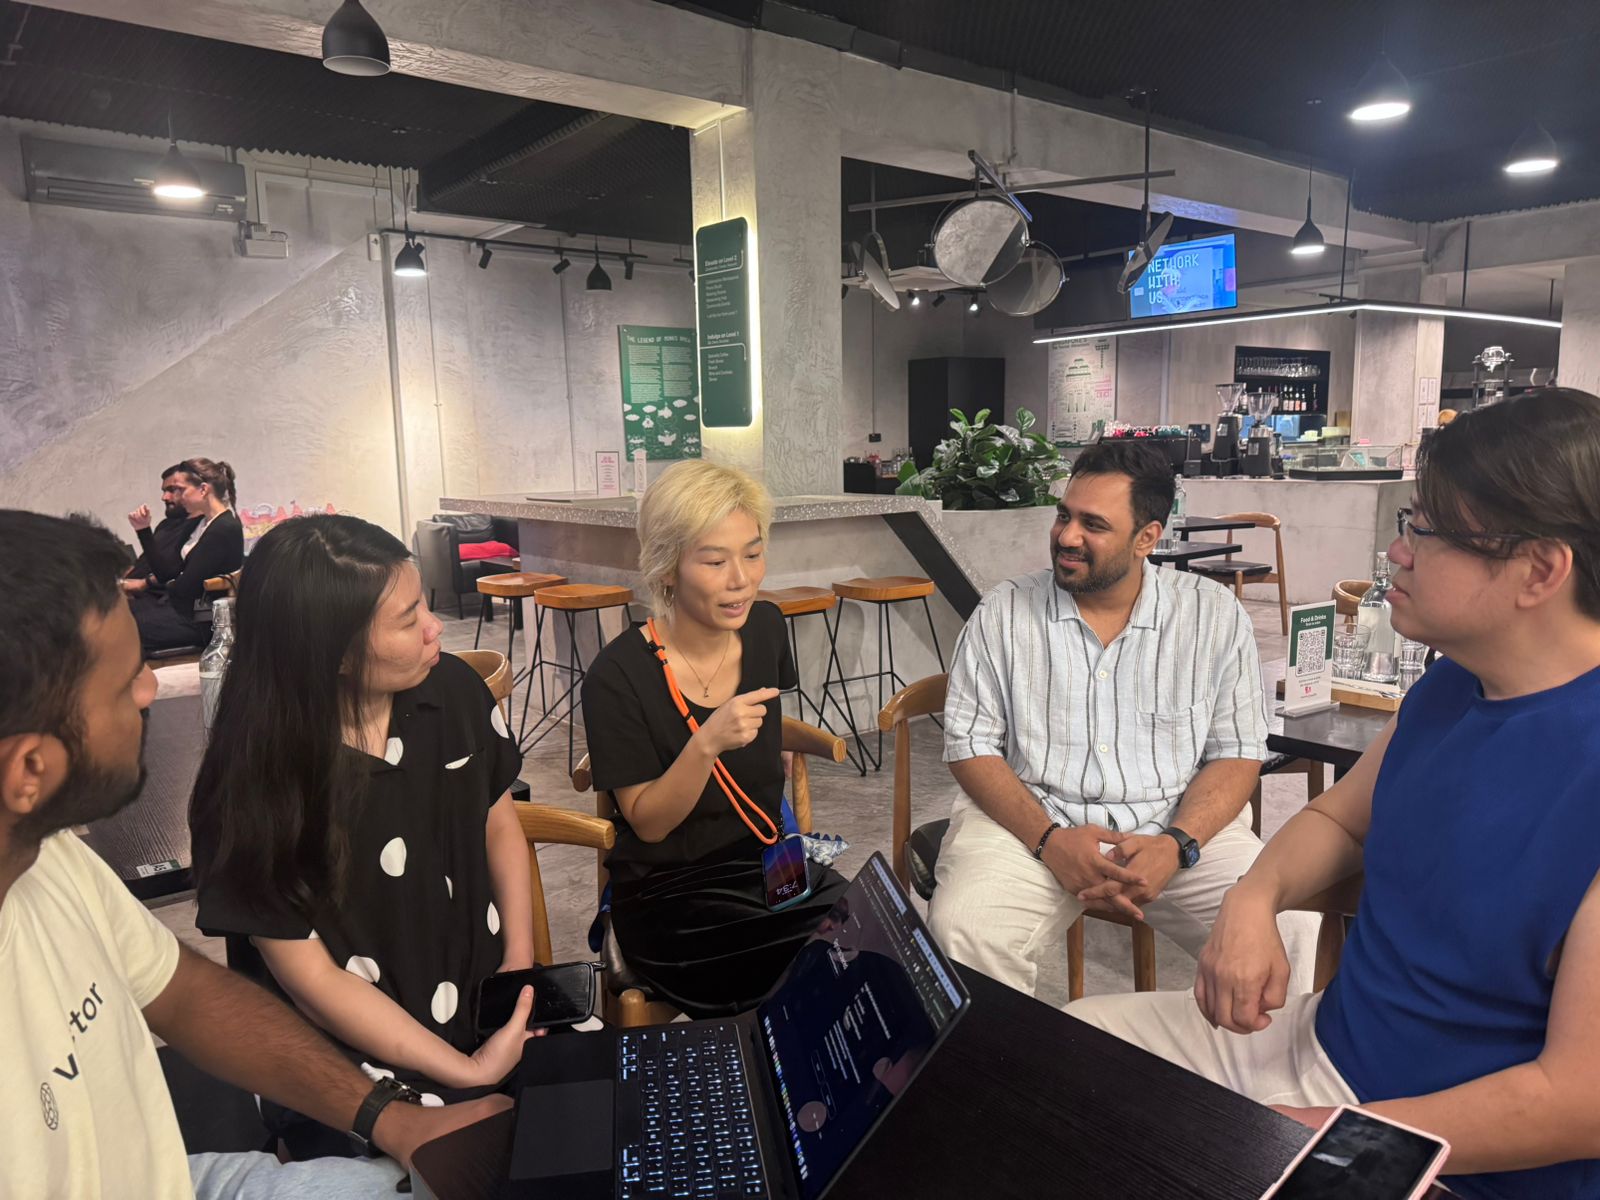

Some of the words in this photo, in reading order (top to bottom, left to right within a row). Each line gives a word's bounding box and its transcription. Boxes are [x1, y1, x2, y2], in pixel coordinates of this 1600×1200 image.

[1148, 253, 1199, 273] NETWORK
[1148, 273, 1178, 289] WITH
[776, 880, 799, 896] 7:34
[53, 982, 104, 1081] vtor
